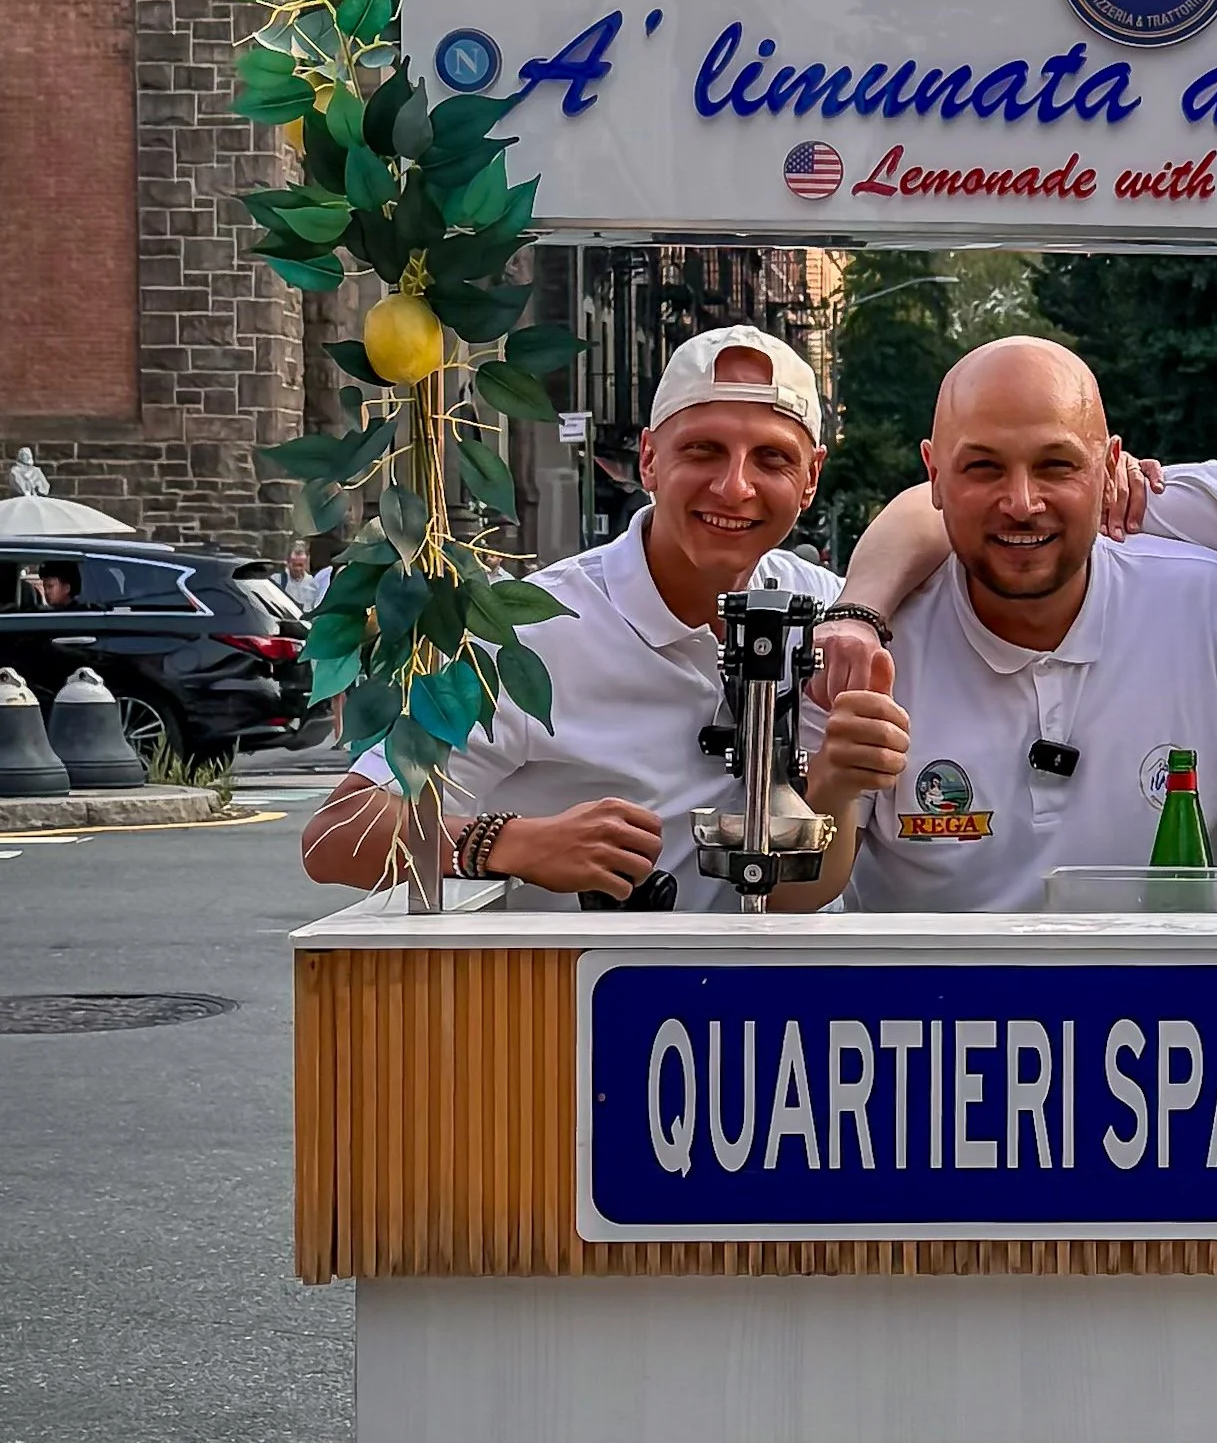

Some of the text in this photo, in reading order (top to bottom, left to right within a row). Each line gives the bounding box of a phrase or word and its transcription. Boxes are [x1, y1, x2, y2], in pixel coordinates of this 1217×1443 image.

[1135, 15, 1144, 28] &
[453, 47, 479, 75] N
[694, 21, 1142, 125] limunata
[852, 144, 1098, 201] Lemonade
[1114, 149, 1217, 202] with
[911, 815, 980, 835] REGA
[647, 1018, 1075, 1178] QUARTIERI
